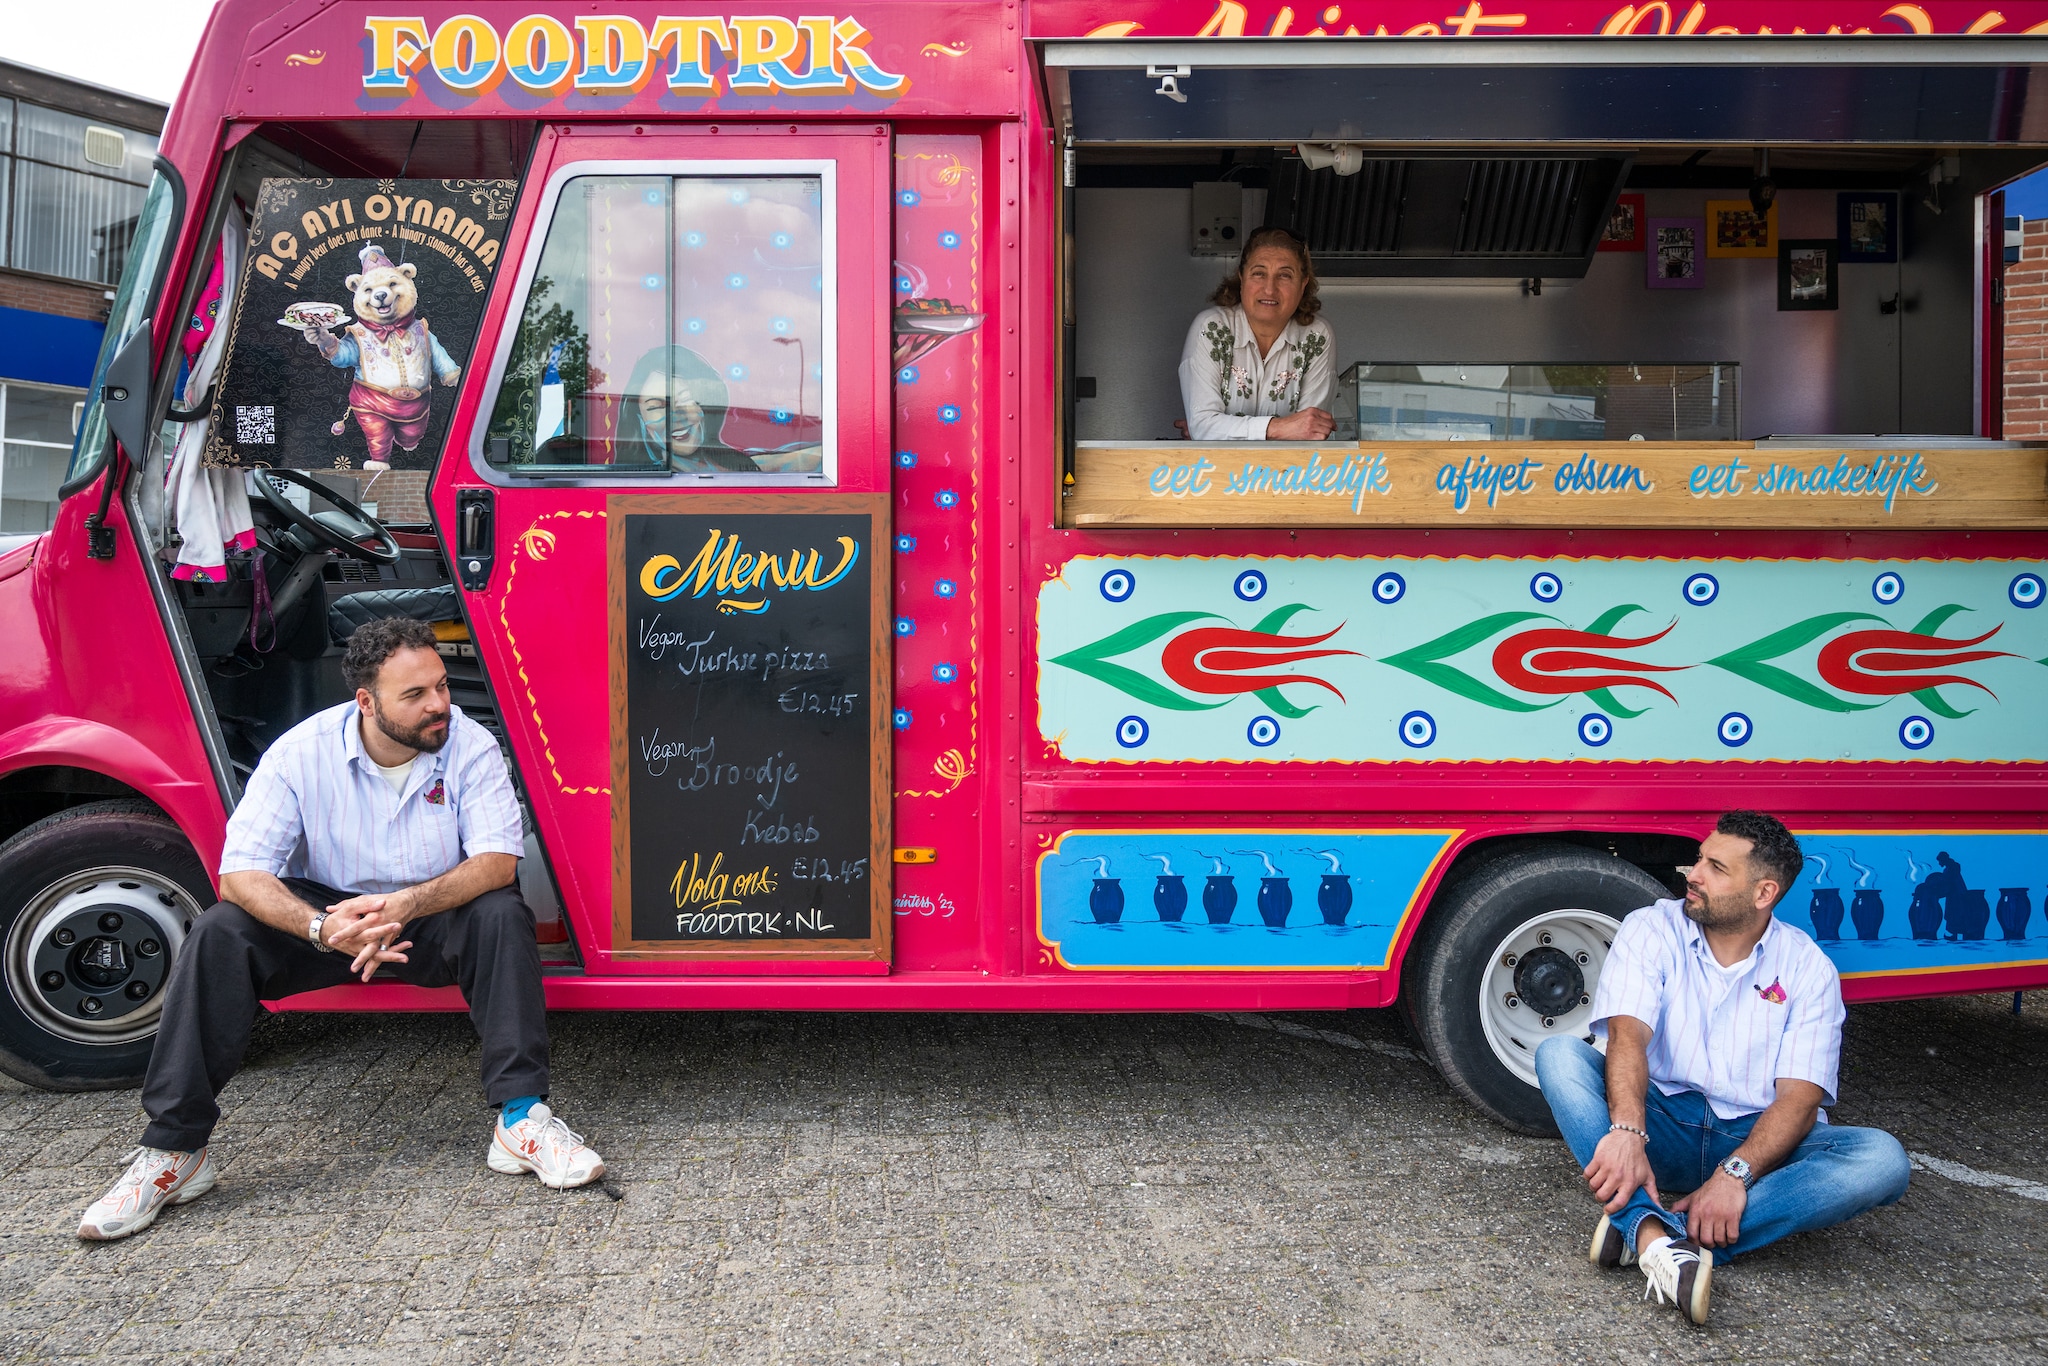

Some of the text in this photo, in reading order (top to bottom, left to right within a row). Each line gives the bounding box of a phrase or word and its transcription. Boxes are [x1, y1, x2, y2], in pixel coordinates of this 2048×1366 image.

[362, 14, 912, 98] FOODTRK
[284, 223, 486, 293] A hungry bear does not dance A hungry stomach has no ears
[302, 199, 355, 239] AYI
[365, 194, 500, 273] OYNAMA
[1150, 452, 1939, 516] eet smakelijk afiyet olsun eet smakelijk
[639, 528, 860, 602] Menu
[639, 613, 686, 661] Vegan
[678, 631, 830, 681] Turkse pizza
[778, 687, 858, 717] €12.45
[640, 728, 694, 777] Vegan
[678, 736, 800, 810] Broodje
[740, 810, 820, 845] Kebab
[669, 852, 779, 911] Volg ons:
[792, 856, 869, 885] €12.45
[894, 893, 935, 916] ainters
